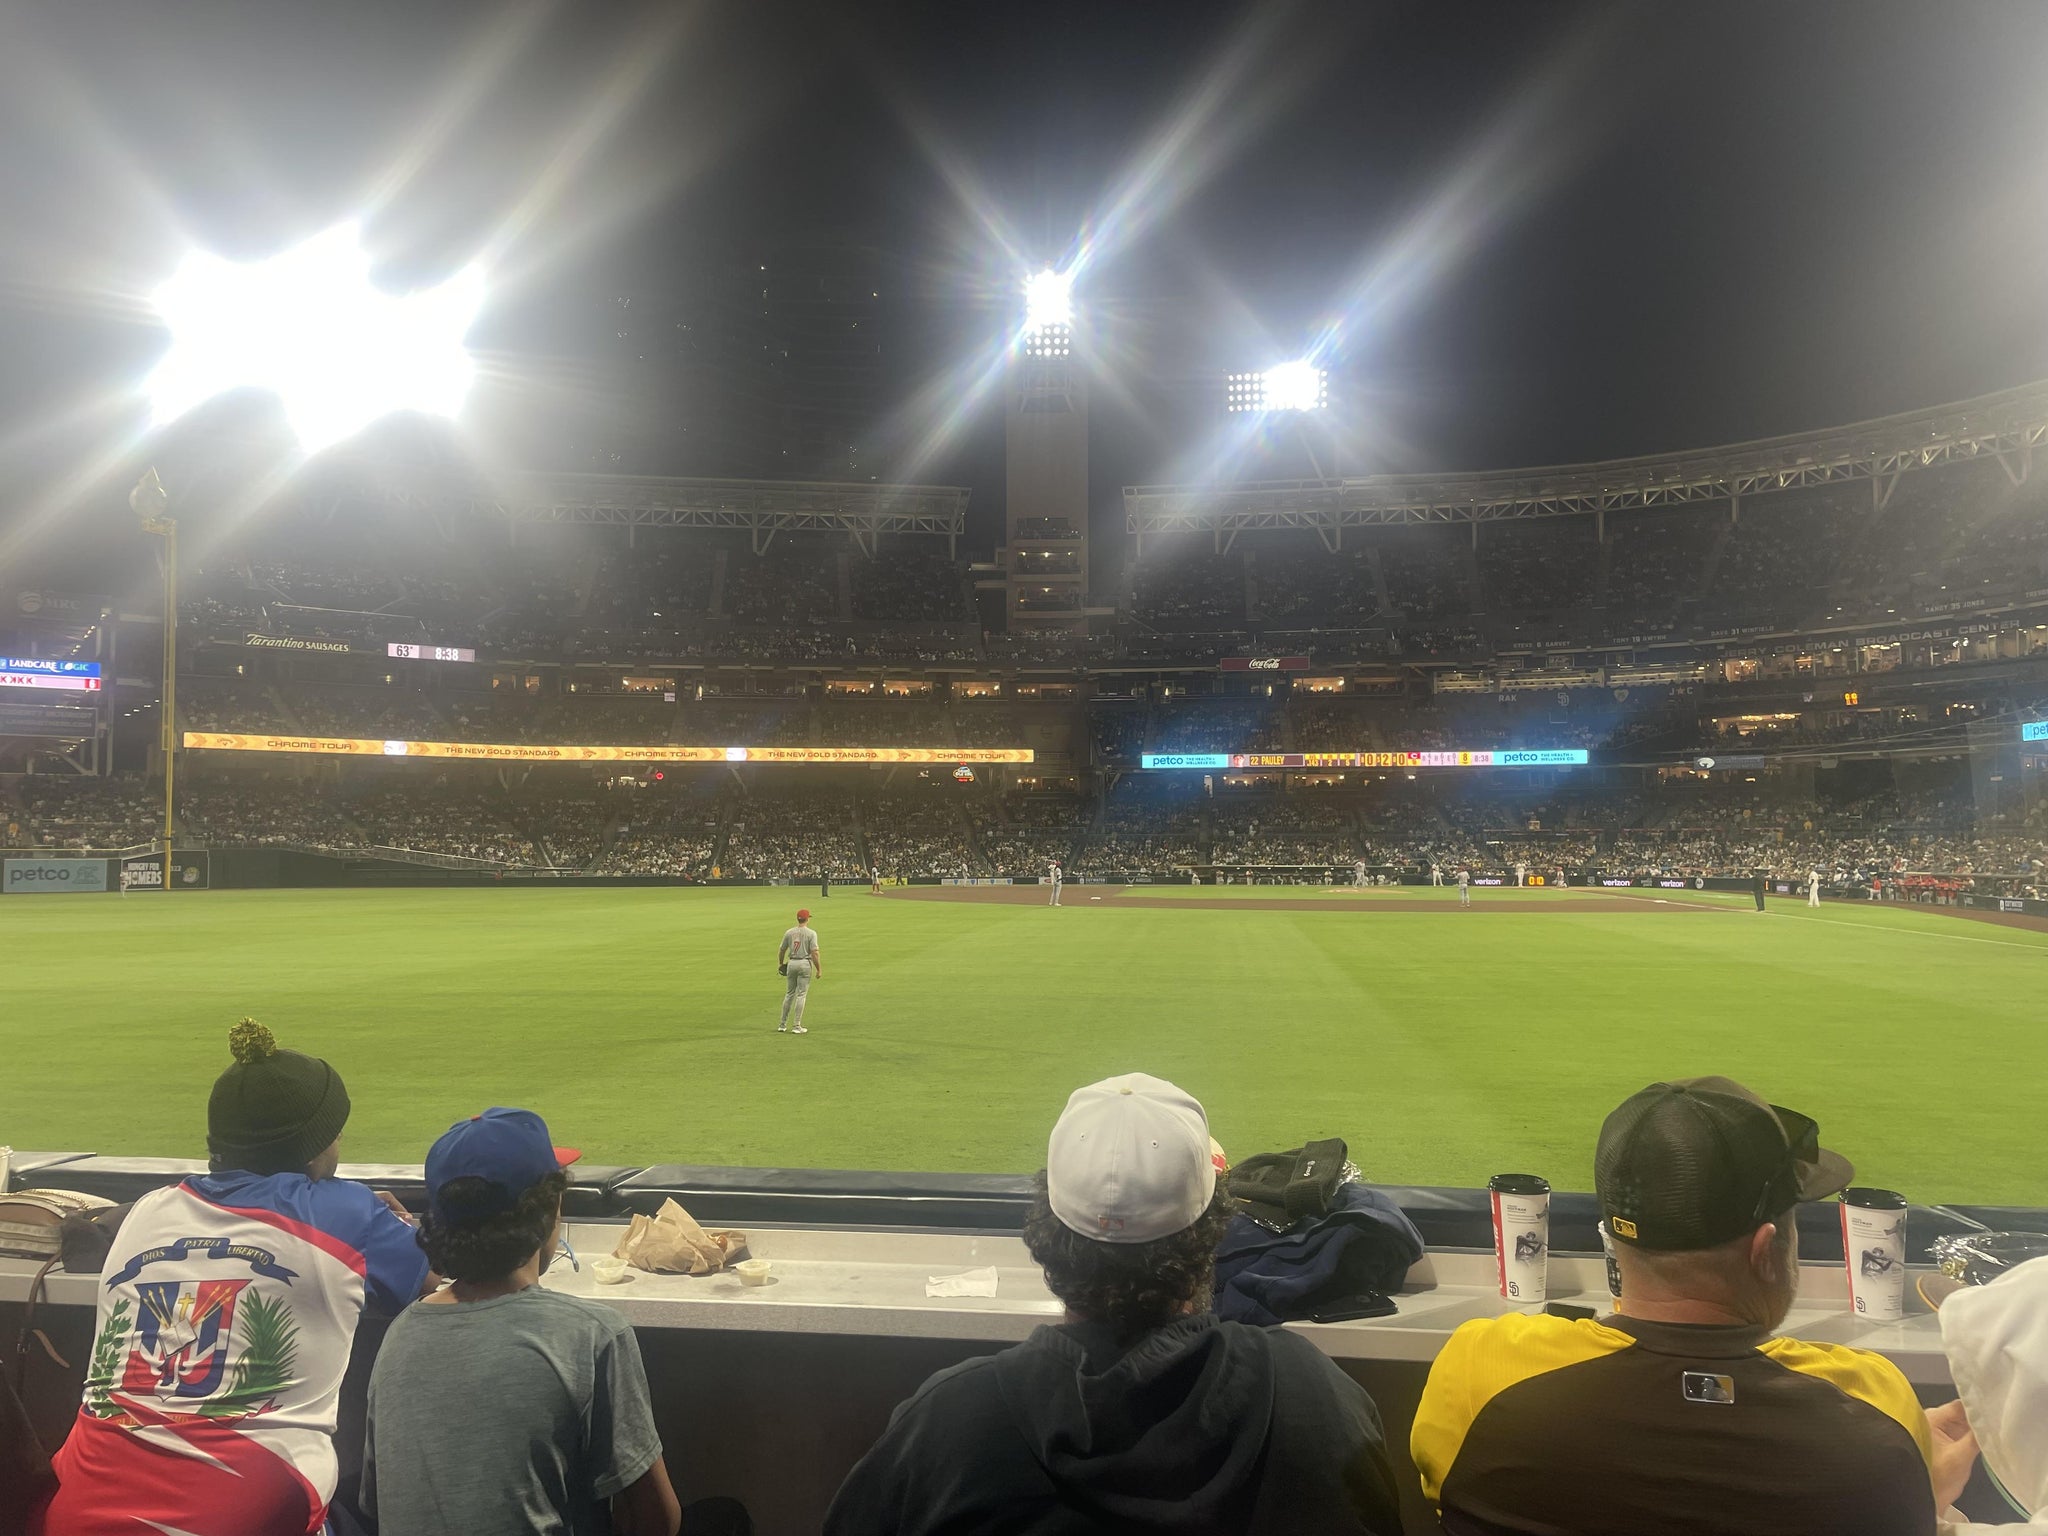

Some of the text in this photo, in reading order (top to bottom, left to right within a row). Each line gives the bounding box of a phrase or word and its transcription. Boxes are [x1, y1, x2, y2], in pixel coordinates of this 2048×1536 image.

[246, 633, 349, 652] Tarantino SAUSAGES
[1775, 639, 1849, 654] COLEMAN
[1856, 629, 1952, 646] BROADCAST
[1958, 619, 2020, 634] CENTER
[435, 647, 459, 661] 8:38
[9, 659, 58, 670] LANDCARE
[267, 740, 352, 750] CHROME TOUR
[1152, 756, 1184, 766] petco
[1250, 756, 1259, 766] 22
[1504, 752, 1538, 764] petco
[10, 866, 70, 884] petco
[1602, 879, 1630, 887] verizon
[142, 1239, 270, 1266] DIOS PATRIA LIBERTAD
